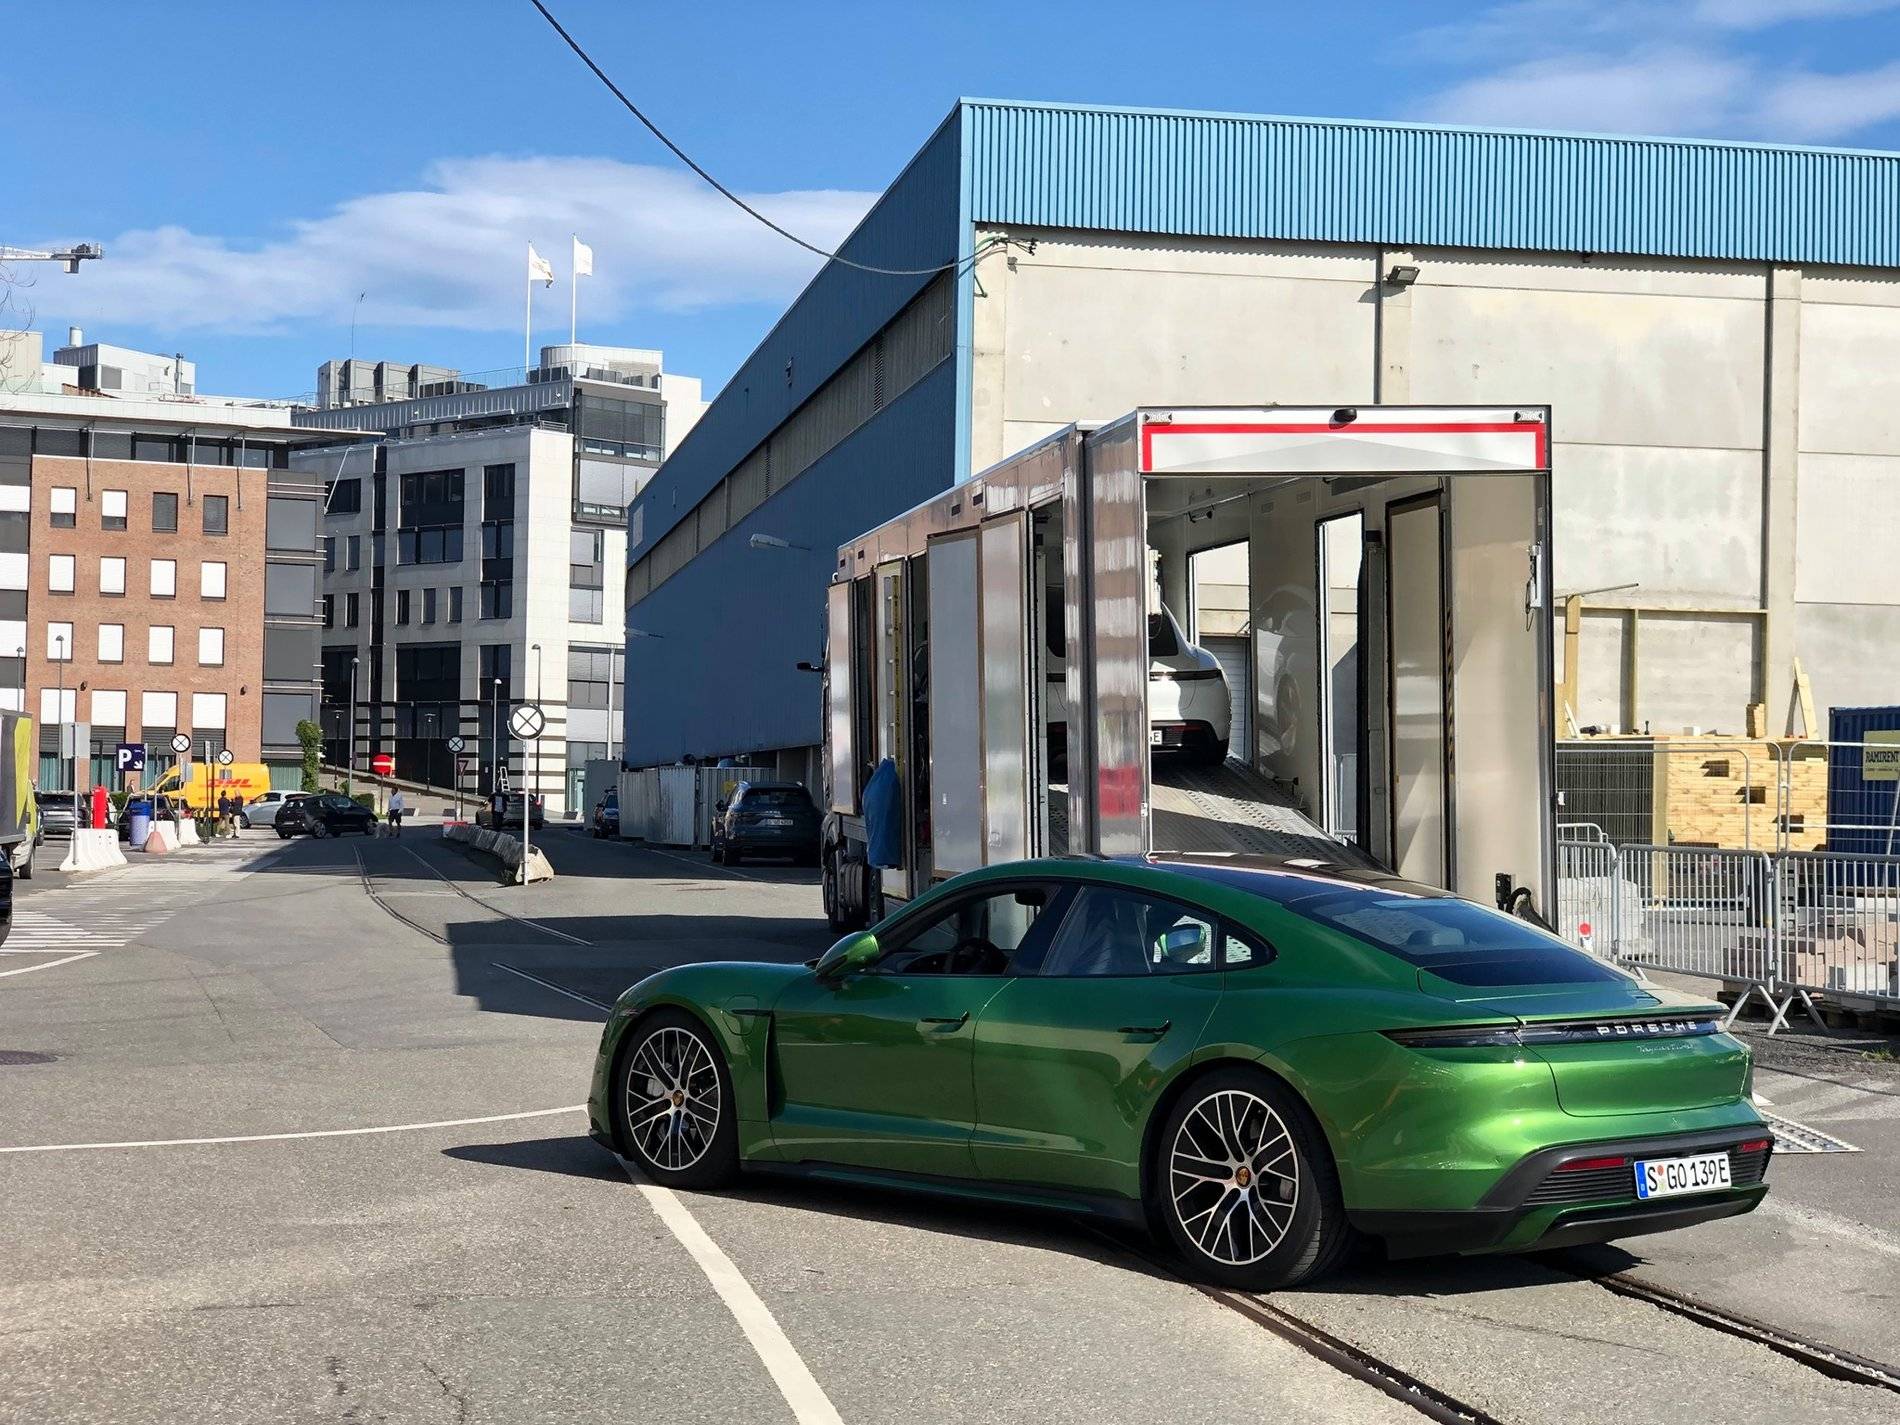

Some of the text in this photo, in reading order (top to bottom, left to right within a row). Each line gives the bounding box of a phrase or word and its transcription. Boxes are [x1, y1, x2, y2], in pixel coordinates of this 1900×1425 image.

[118, 749, 132, 769] P
[1865, 751, 1899, 762] RAMIRENT
[207, 779, 252, 787] DHL
[1596, 1021, 1697, 1035] PORSCHE
[1647, 1158, 1729, 1192] S GO 139E
